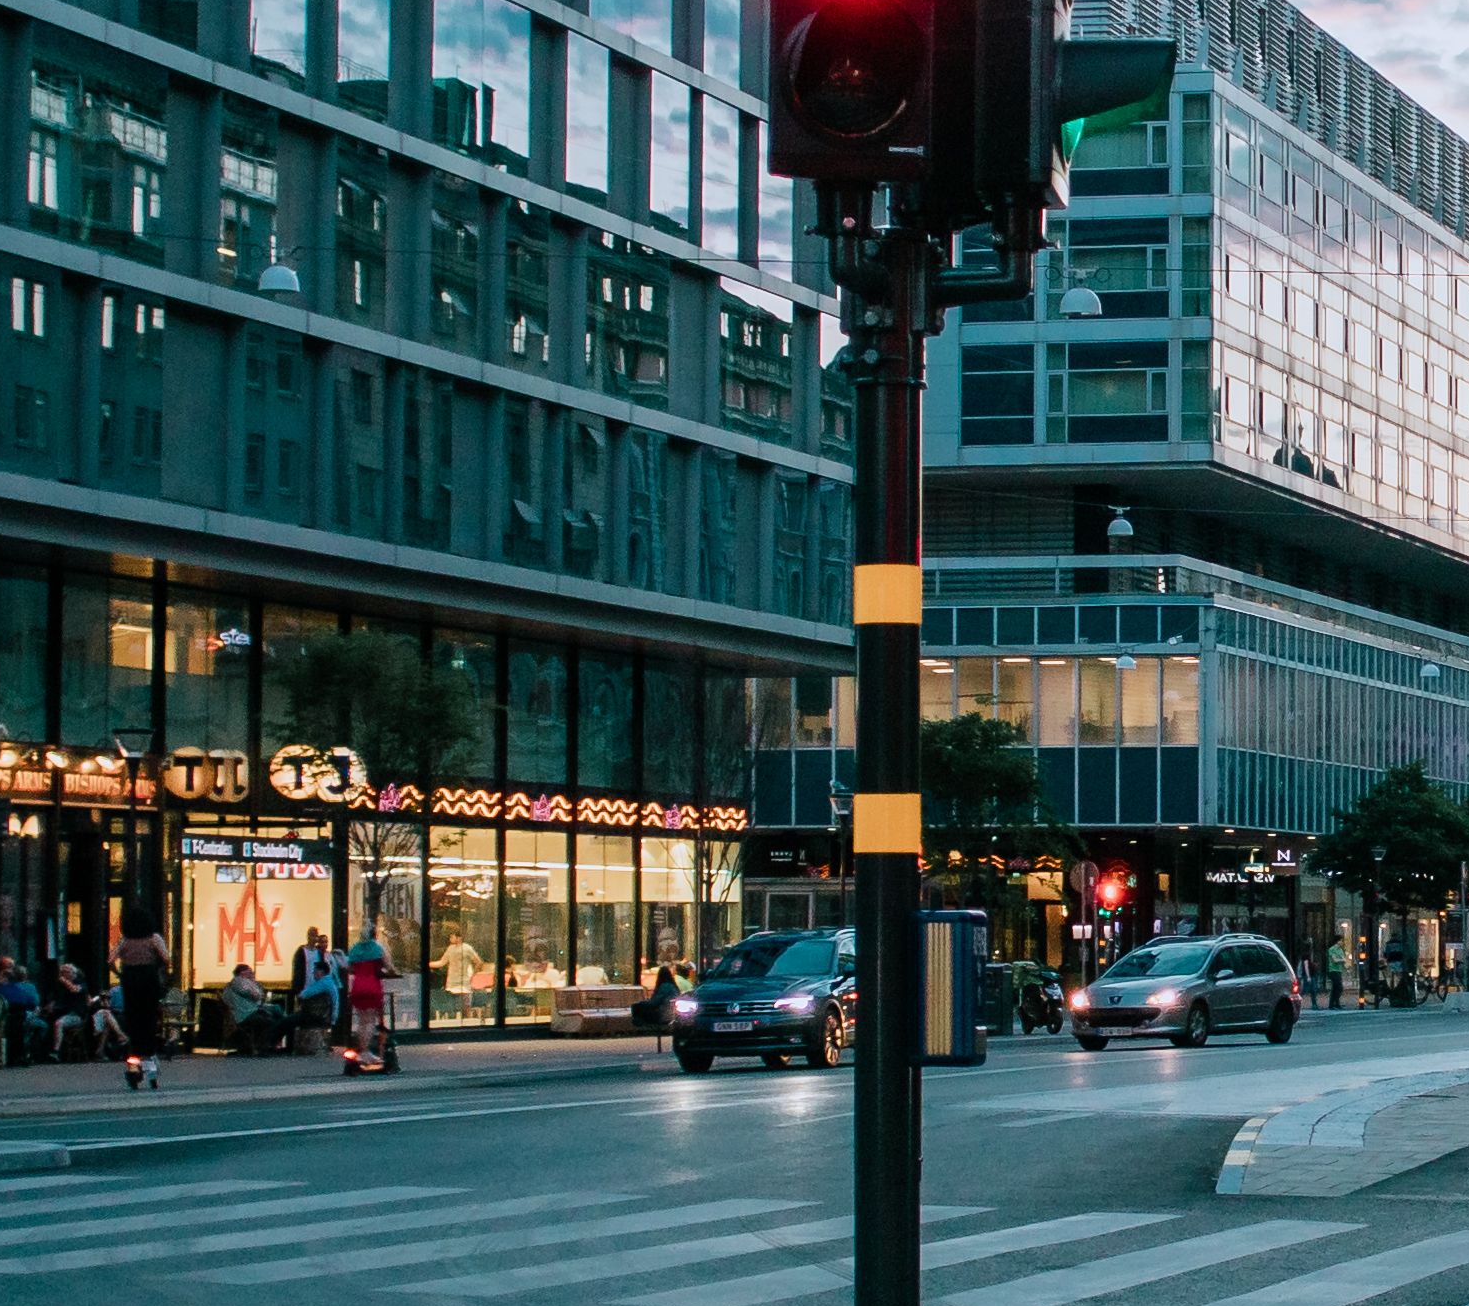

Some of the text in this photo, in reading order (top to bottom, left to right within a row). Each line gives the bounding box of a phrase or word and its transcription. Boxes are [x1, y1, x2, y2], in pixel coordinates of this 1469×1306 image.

[13, 769, 52, 792] ARMS
[62, 772, 122, 796] BISHOPS
[191, 838, 304, 862] T-Centralen Stockholm City
[216, 878, 284, 967] MAX
